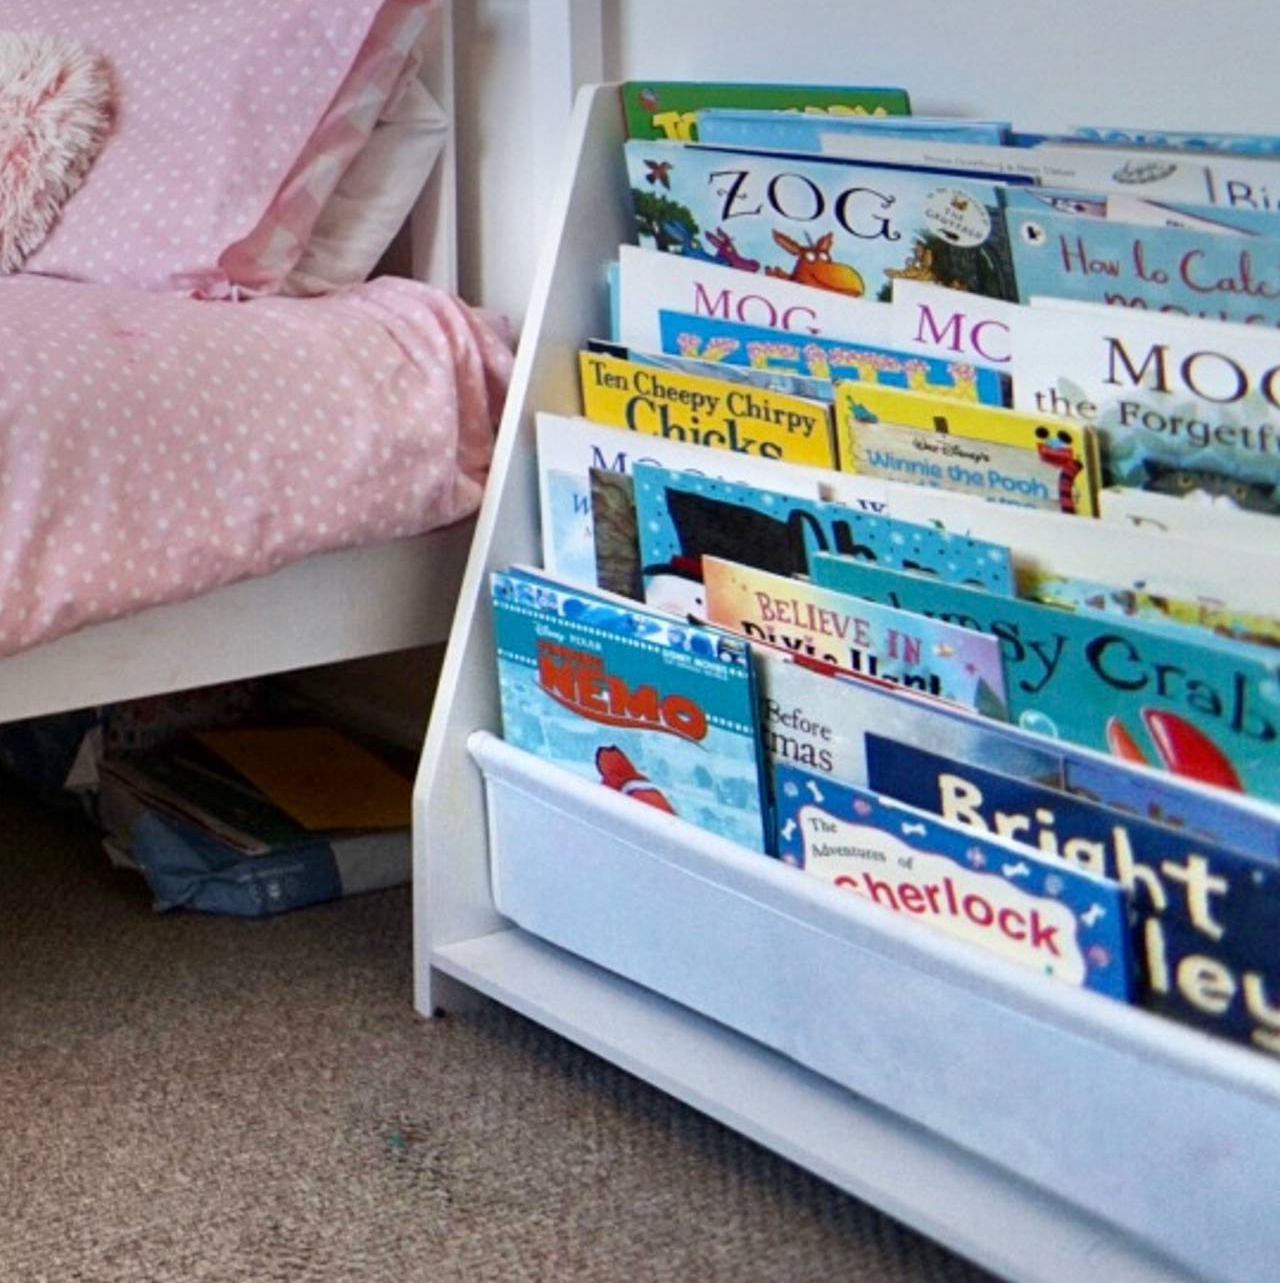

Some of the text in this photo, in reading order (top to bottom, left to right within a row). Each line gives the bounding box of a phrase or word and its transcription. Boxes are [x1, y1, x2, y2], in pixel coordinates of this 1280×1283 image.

[707, 170, 902, 242] ZOG
[1059, 233, 1120, 277] How
[693, 281, 821, 334] MOG
[589, 359, 817, 438] Ten Cheepy Chirpy
[1034, 386, 1280, 453] the Forgetf
[866, 448, 942, 478] Winnie
[947, 463, 985, 486] the
[987, 470, 1050, 501] Pooh
[755, 591, 872, 648] BELIEVE
[885, 628, 923, 664] IN
[538, 655, 708, 741] NEMO
[1085, 634, 1278, 743] Crab
[808, 817, 838, 835] The
[811, 843, 915, 871] Adventures of
[938, 772, 1229, 942] Bright
